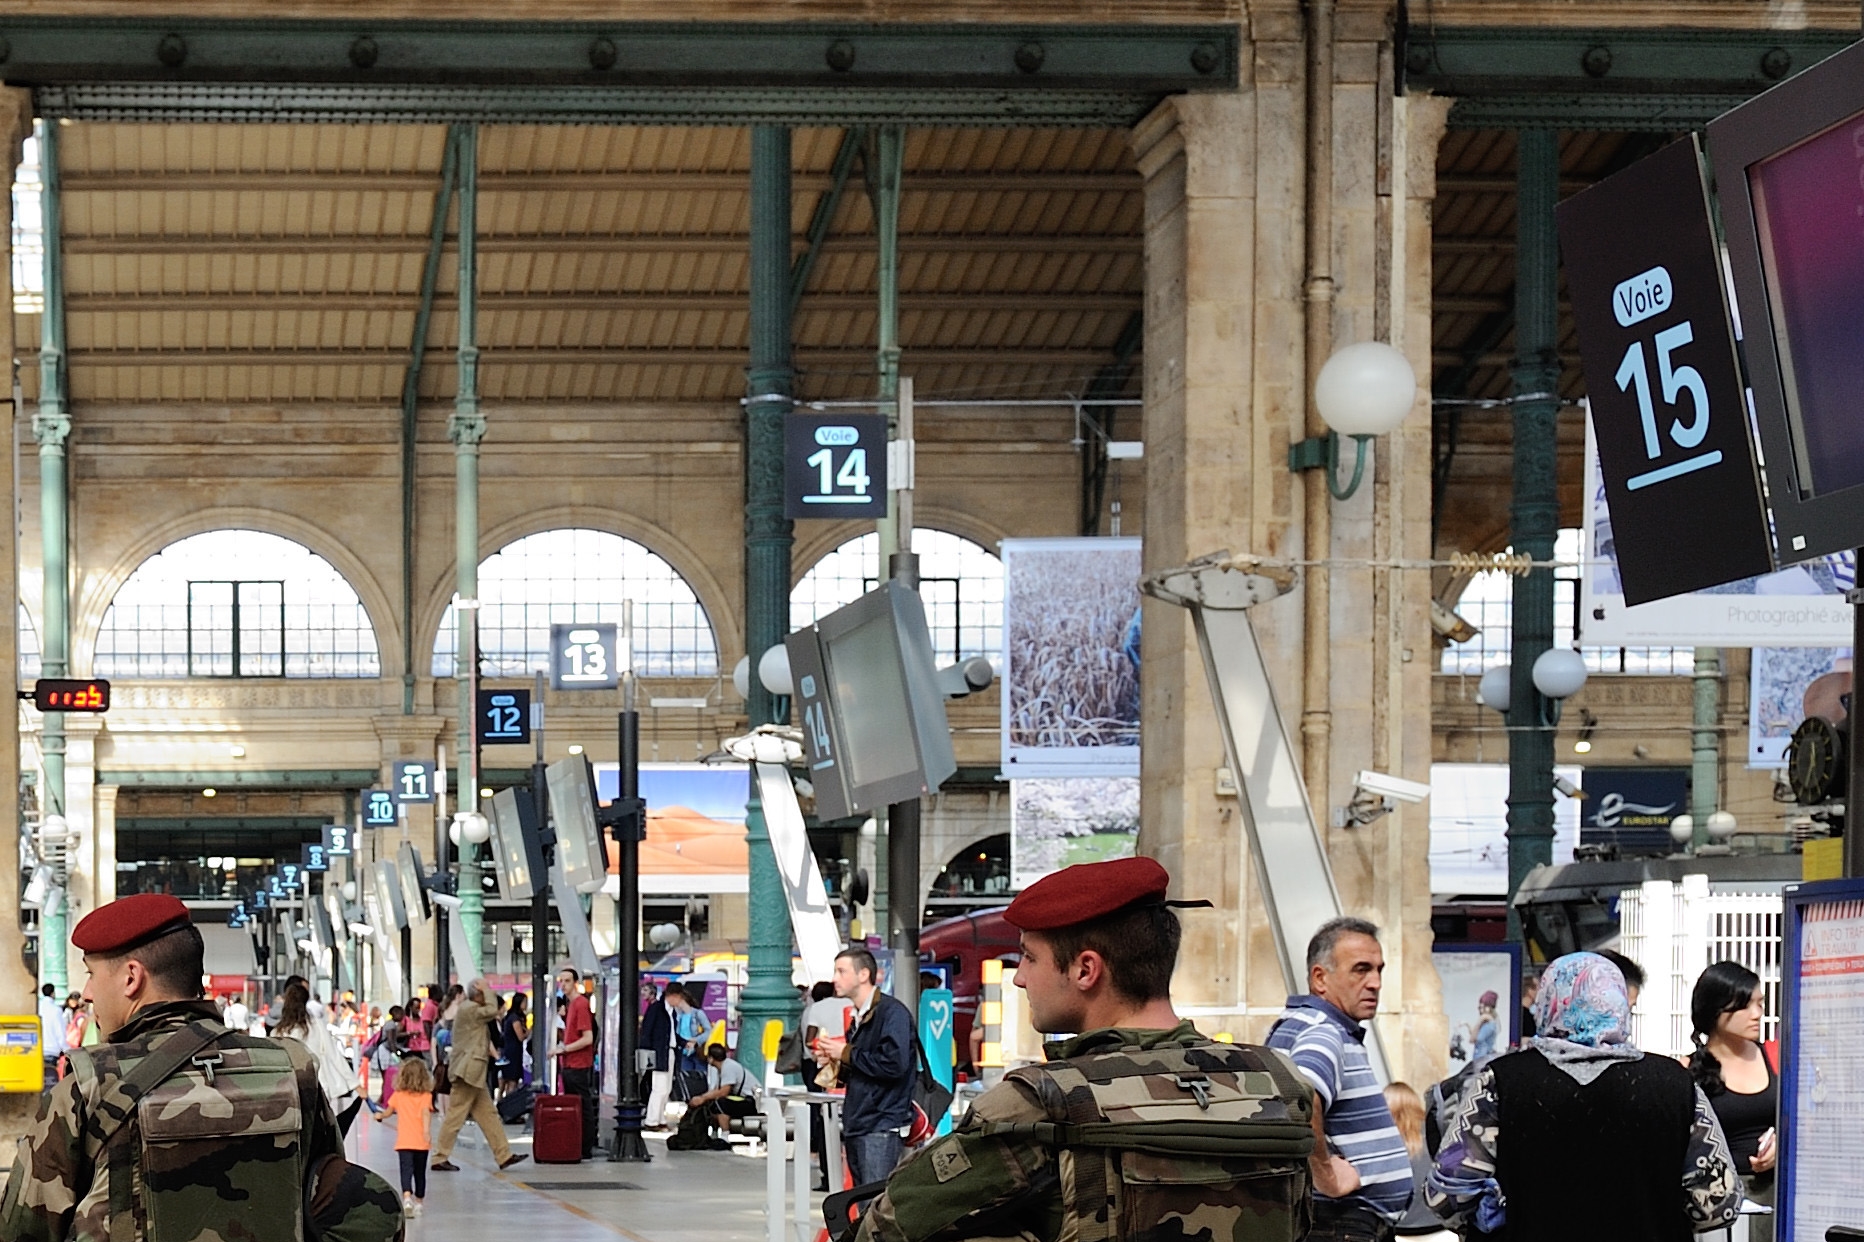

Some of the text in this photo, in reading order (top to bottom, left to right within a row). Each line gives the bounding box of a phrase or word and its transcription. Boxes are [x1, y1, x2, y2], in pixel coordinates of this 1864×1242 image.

[1619, 279, 1664, 317] Voie
[1615, 320, 1710, 460] 15
[821, 430, 852, 441] Voie
[807, 448, 870, 495] 14
[1728, 606, 1828, 627] Photographié
[564, 643, 607, 675] 13
[487, 706, 521, 733] 12
[805, 702, 831, 759] 14
[400, 774, 428, 795] 11
[368, 801, 394, 819] 10
[1622, 815, 1670, 826] EUROSTAR
[332, 836, 345, 850] 9
[310, 852, 323, 867] 8
